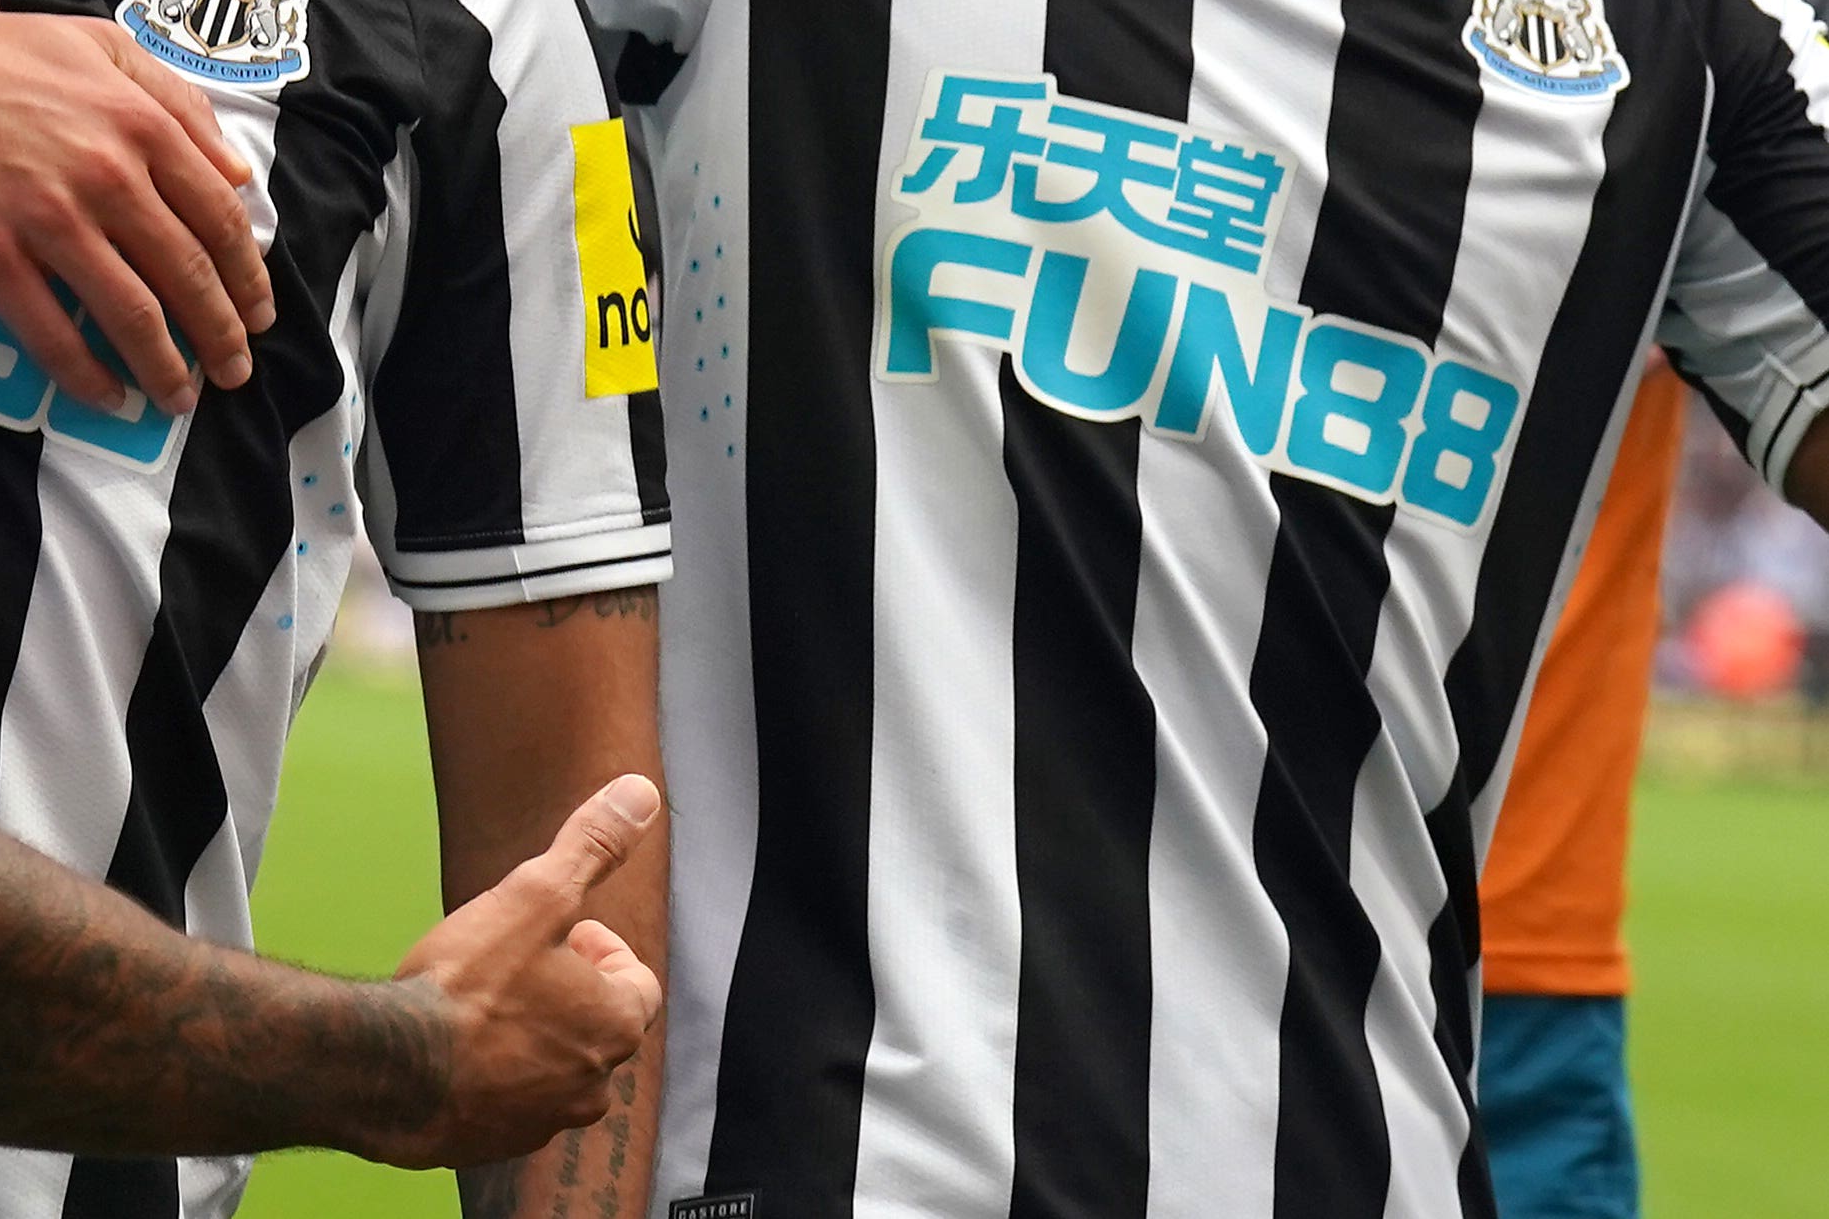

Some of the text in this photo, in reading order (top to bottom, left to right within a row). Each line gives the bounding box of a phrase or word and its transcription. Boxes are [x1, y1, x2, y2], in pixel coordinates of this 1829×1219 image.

[142, 32, 272, 79] NEWCASTLE UNITED
[900, 75, 1284, 275] 乐天堂
[886, 227, 1520, 527] FUN88
